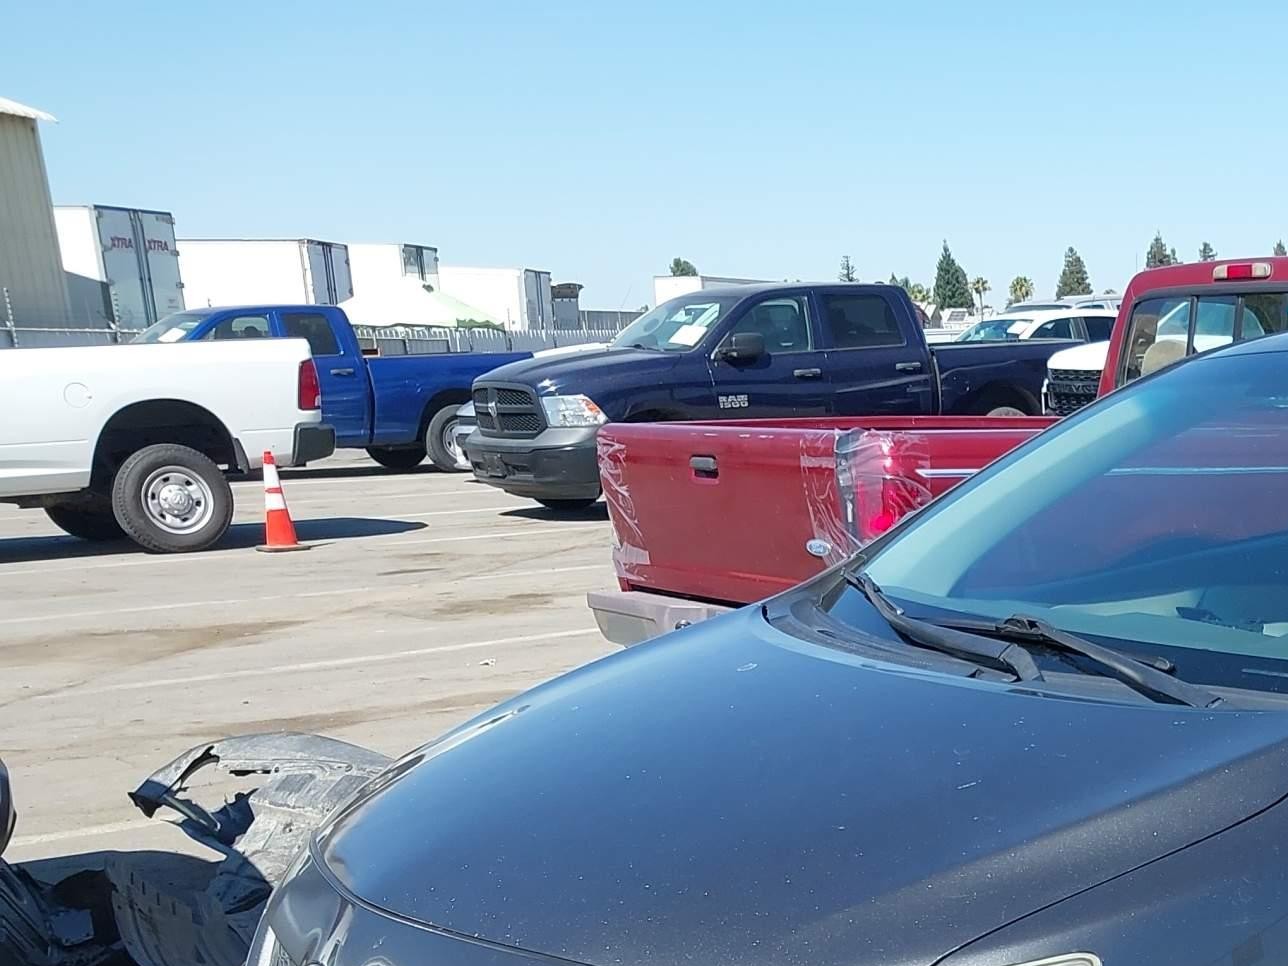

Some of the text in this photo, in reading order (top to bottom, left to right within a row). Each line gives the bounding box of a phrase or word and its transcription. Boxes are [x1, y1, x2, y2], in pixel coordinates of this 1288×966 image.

[110, 236, 134, 249] XTRA
[147, 239, 169, 252] XTRA
[720, 400, 749, 408] 1500
